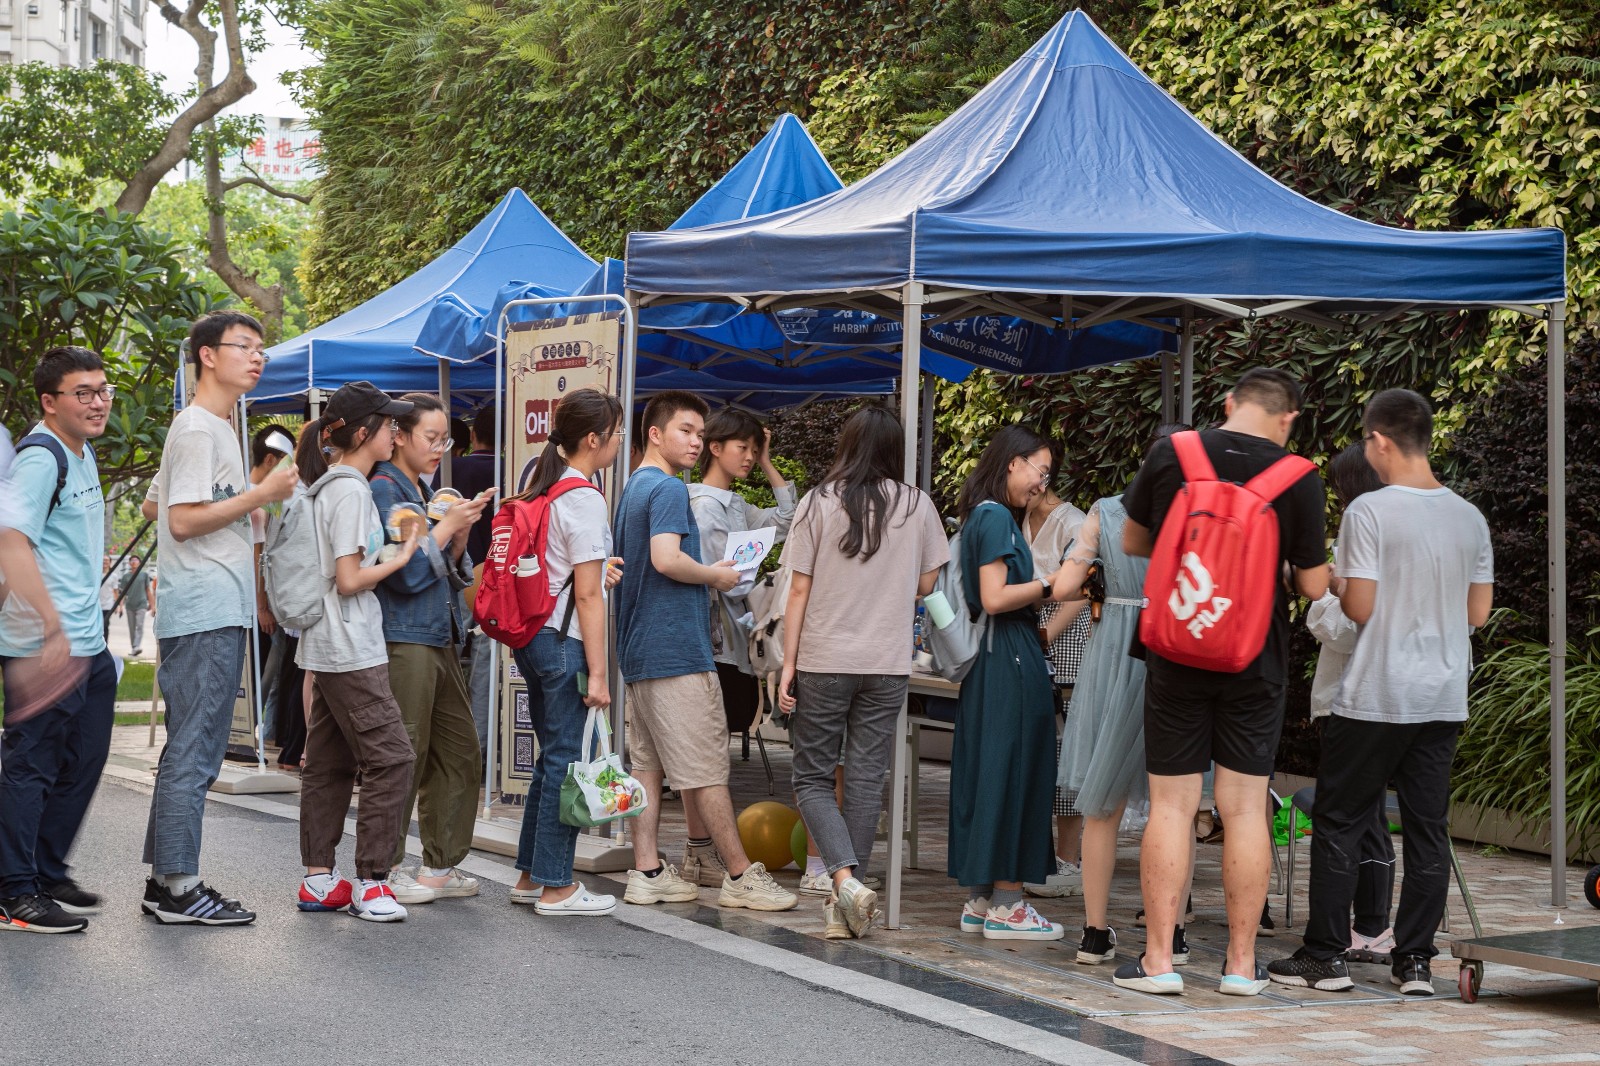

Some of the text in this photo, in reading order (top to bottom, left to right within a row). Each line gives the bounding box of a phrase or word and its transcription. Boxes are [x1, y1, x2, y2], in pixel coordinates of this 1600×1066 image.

[833, 323, 869, 334] HARBIN
[927, 328, 1023, 368] TECHNOLOGY, SHENZHEN
[526, 411, 549, 435] OH
[1186, 596, 1233, 639] FILA
